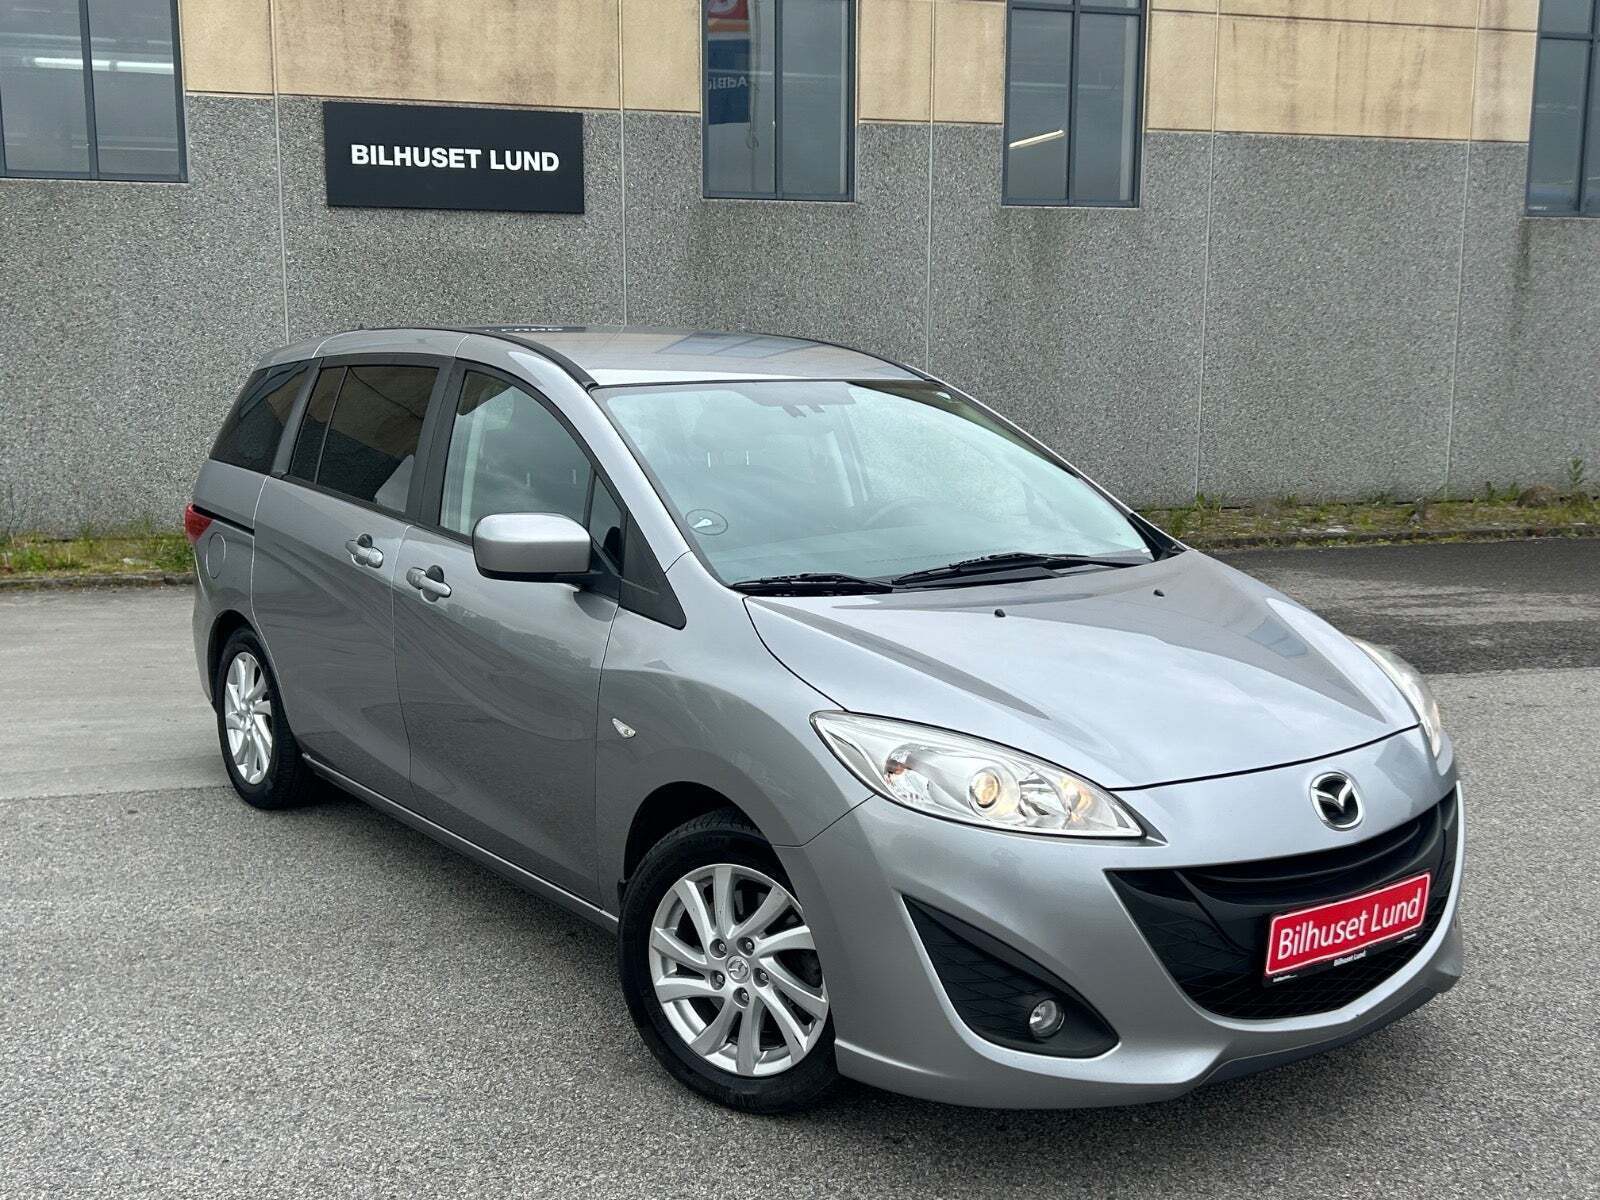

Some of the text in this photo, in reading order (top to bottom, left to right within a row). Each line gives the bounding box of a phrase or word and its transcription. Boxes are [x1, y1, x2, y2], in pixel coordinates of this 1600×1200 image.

[351, 144, 559, 171] BILHUSET LUND
[1277, 888, 1422, 960] Bilhuset Lund
